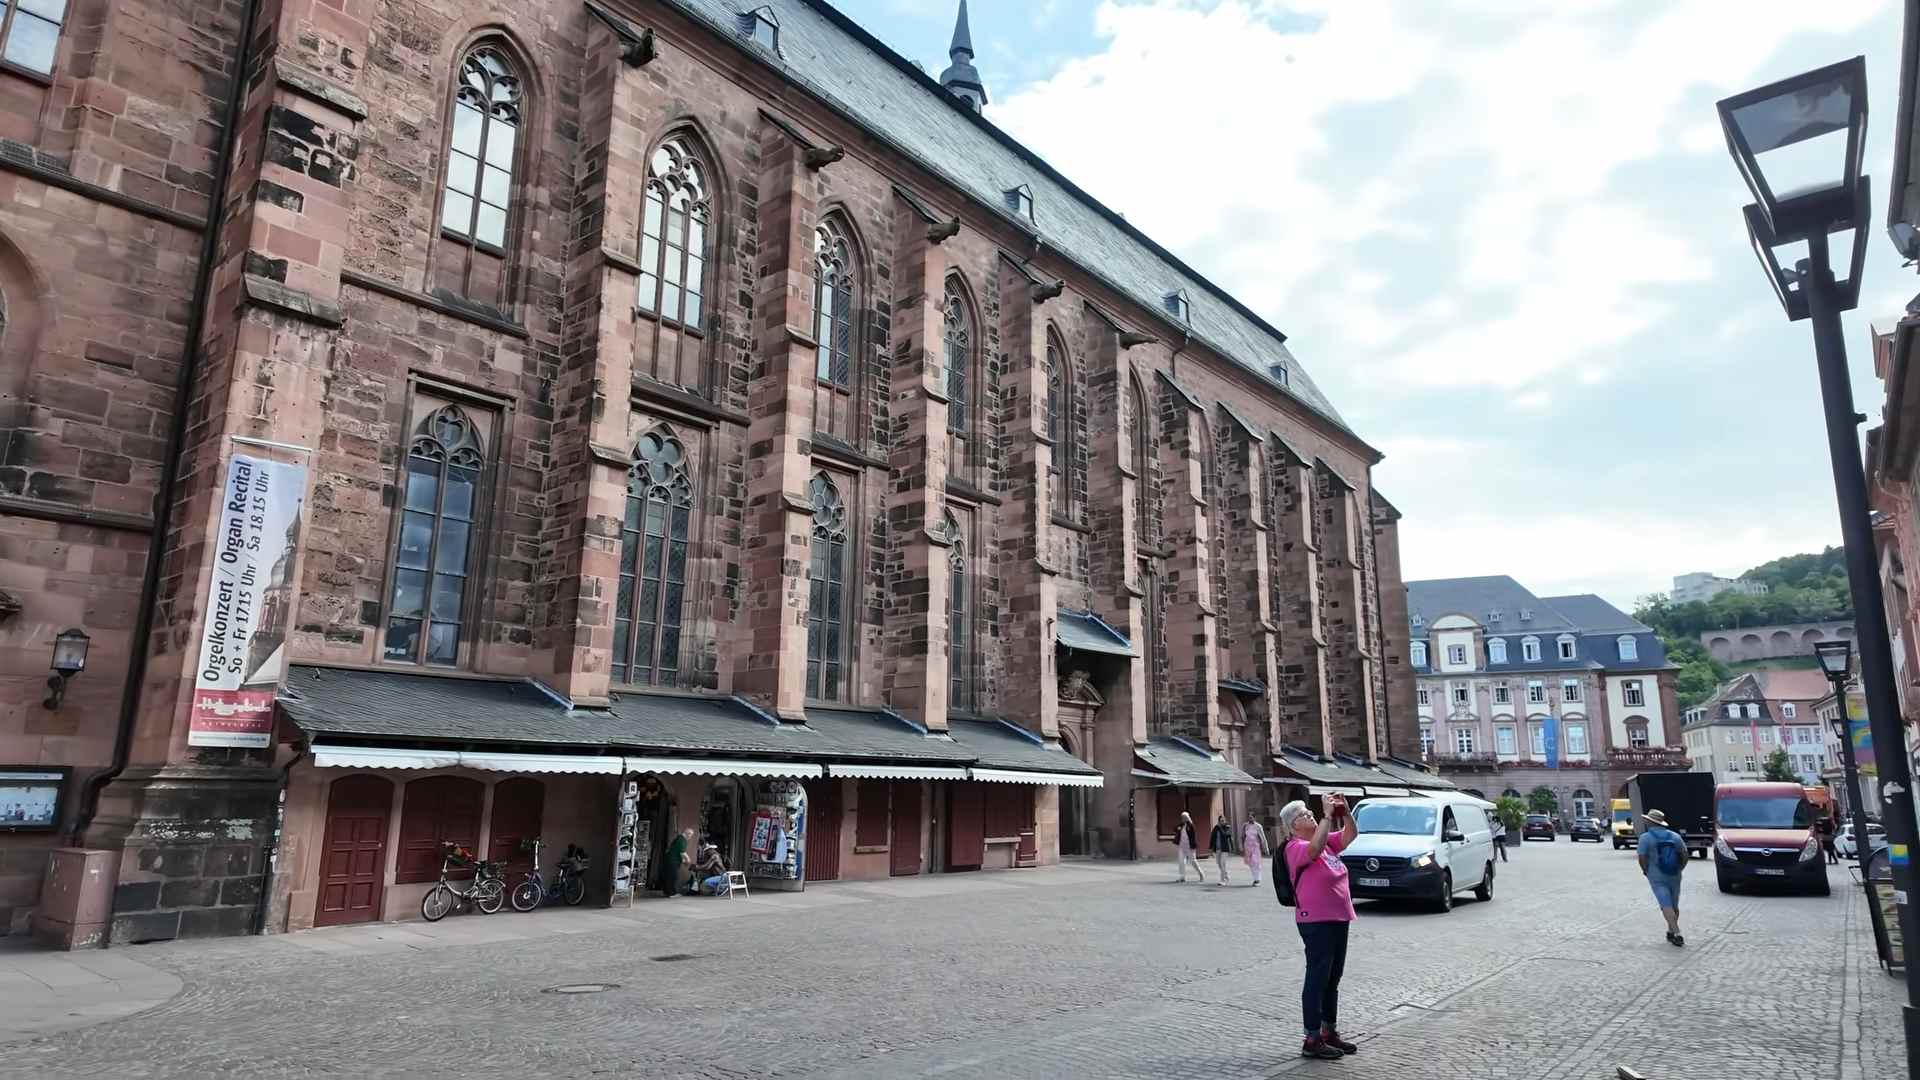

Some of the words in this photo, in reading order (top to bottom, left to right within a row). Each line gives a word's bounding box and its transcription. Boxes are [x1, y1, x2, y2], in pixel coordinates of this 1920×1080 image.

[228, 460, 252, 513] Recital
[255, 471, 270, 492] Uhr
[249, 496, 266, 532] 18.15
[220, 517, 244, 564] Organ
[246, 536, 261, 552] Sa
[221, 567, 235, 577] /
[240, 563, 257, 586] Uhr
[203, 580, 234, 682] Orgelkonzert
[232, 627, 247, 641] Fr
[227, 657, 243, 674] So
